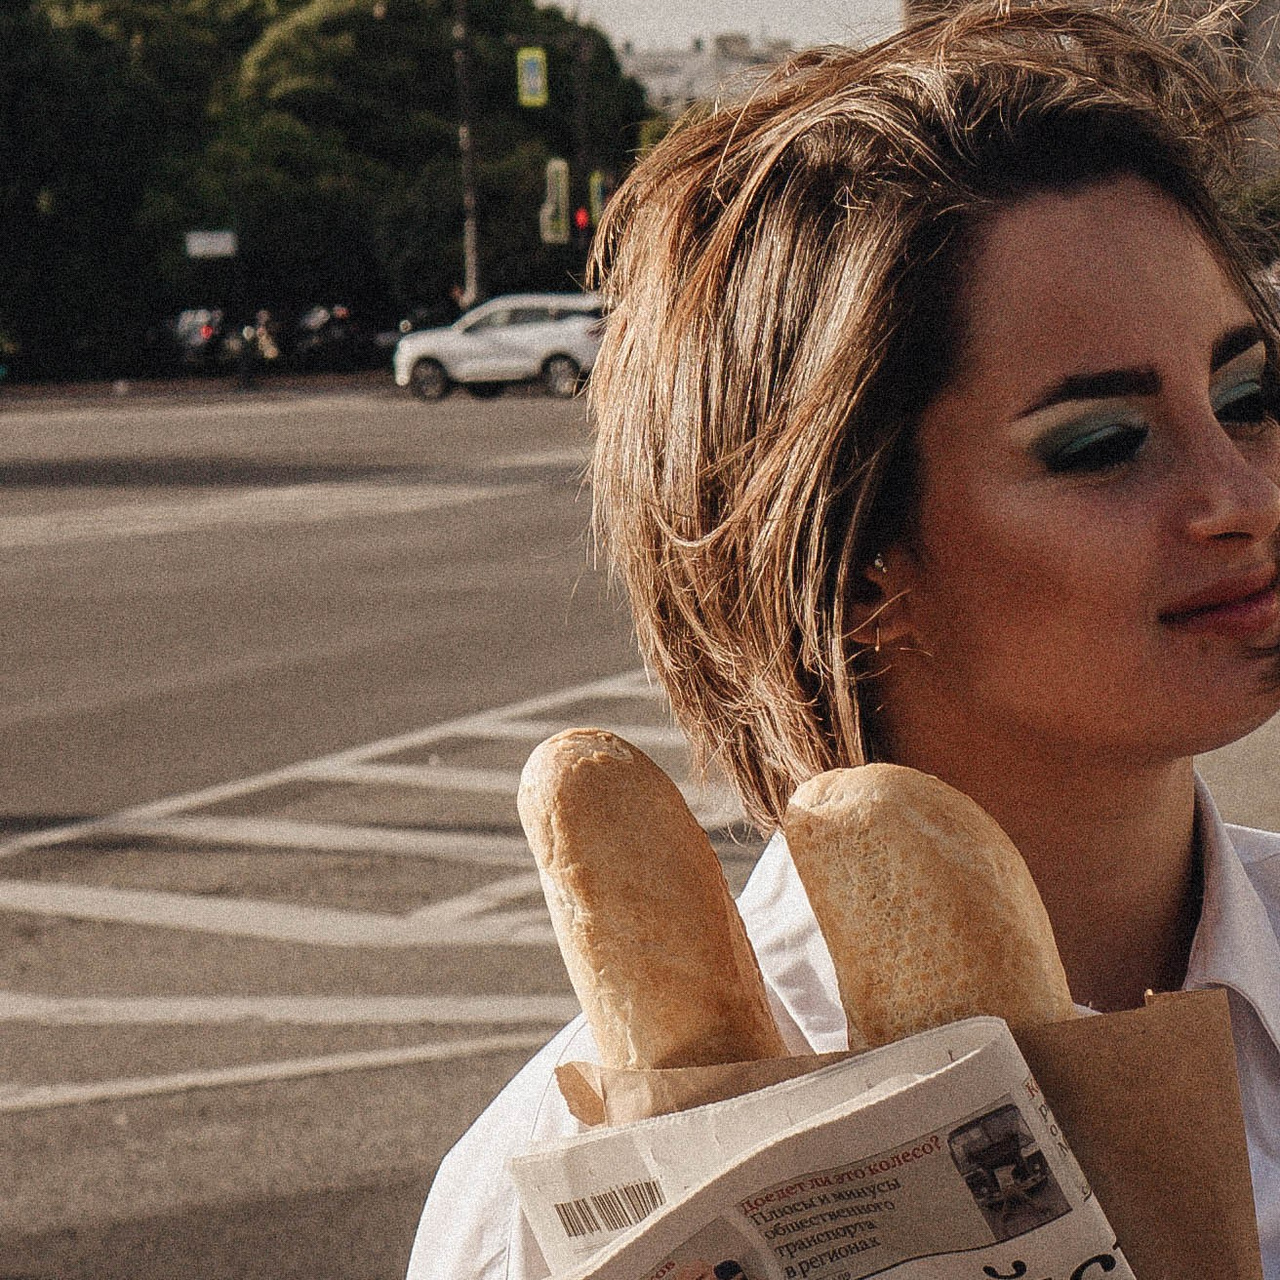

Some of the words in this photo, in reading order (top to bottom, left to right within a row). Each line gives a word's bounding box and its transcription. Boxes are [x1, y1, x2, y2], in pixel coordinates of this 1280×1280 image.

[741, 1179, 807, 1216] Доедет
[809, 1174, 834, 1190] ли
[835, 1168, 867, 1186] это
[867, 1135, 943, 1177] колесо?
[749, 1195, 816, 1227] Плюсы
[831, 1178, 902, 1204] минусы
[764, 1200, 896, 1241] общественного
[773, 1219, 878, 1259] транспорта
[784, 1265, 798, 1280] в
[798, 1235, 882, 1278] регионах
